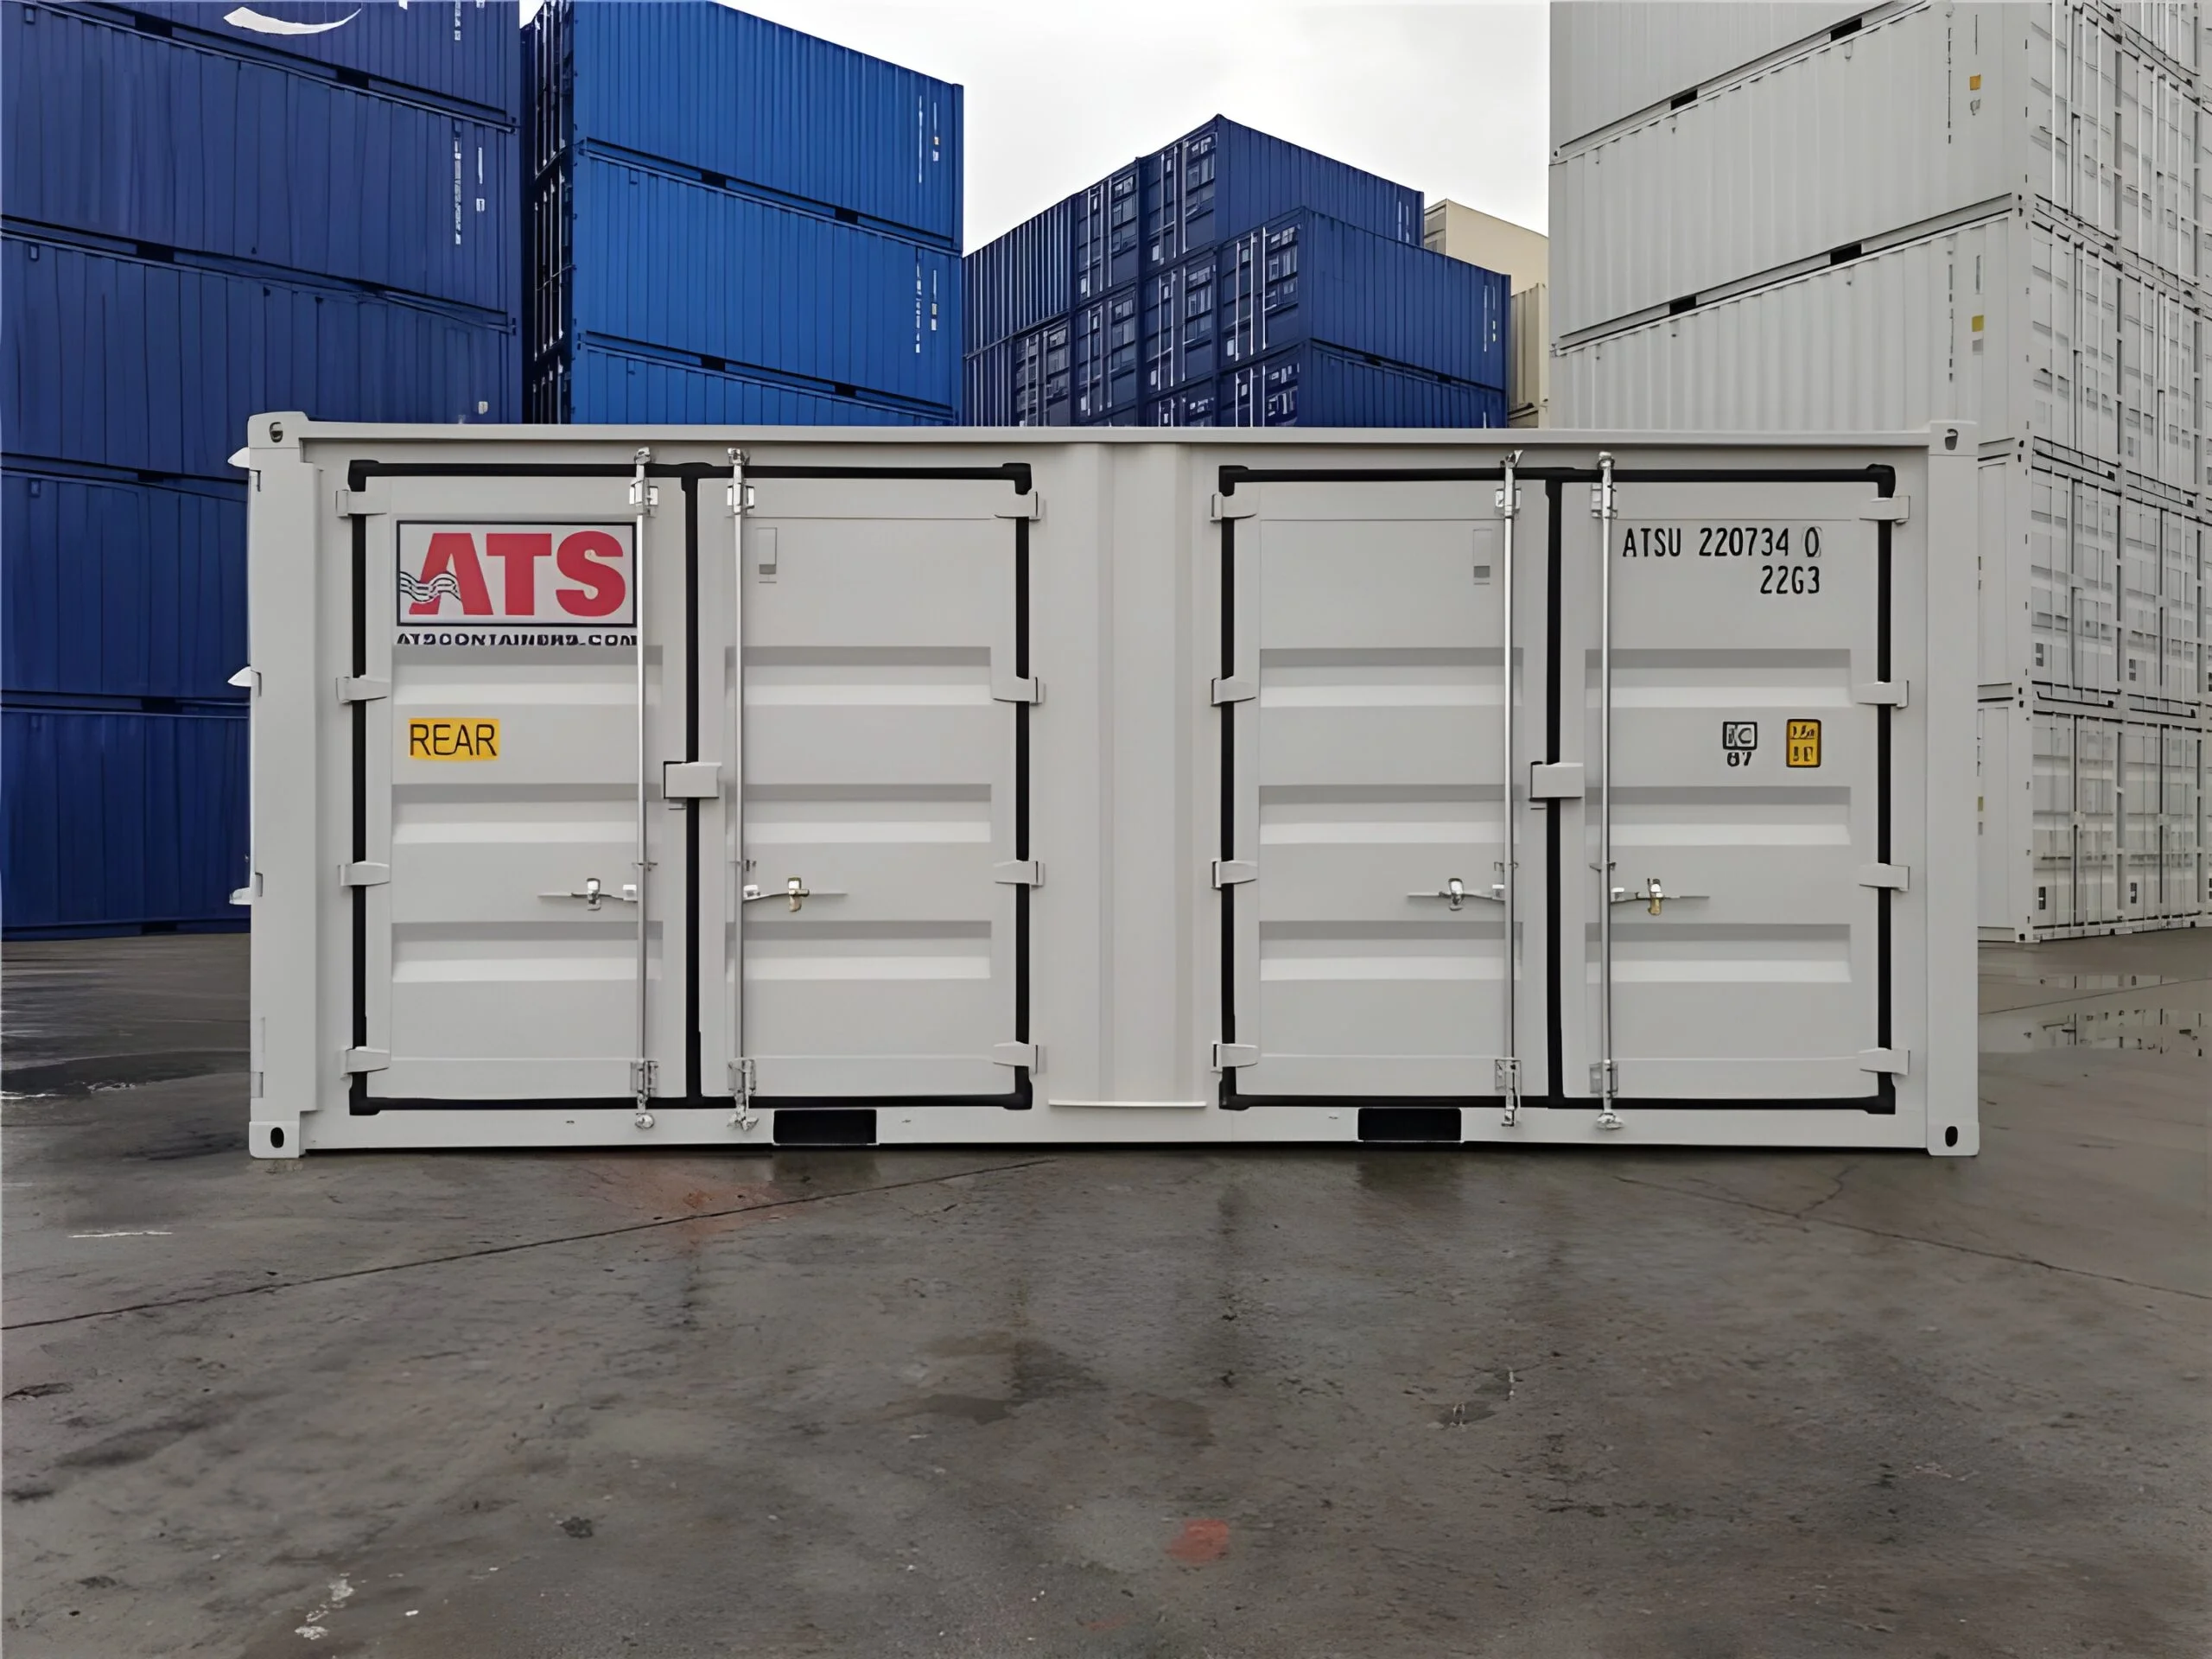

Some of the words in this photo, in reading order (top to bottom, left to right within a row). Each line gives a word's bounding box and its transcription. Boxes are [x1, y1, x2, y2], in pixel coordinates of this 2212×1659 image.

[1622, 527, 1681, 557] ATSU
[1698, 527, 1789, 557] 220734
[1804, 526, 1820, 558] 0
[409, 531, 626, 617] ATS
[1759, 564, 1821, 594] 22G3
[410, 723, 497, 756] REAR
